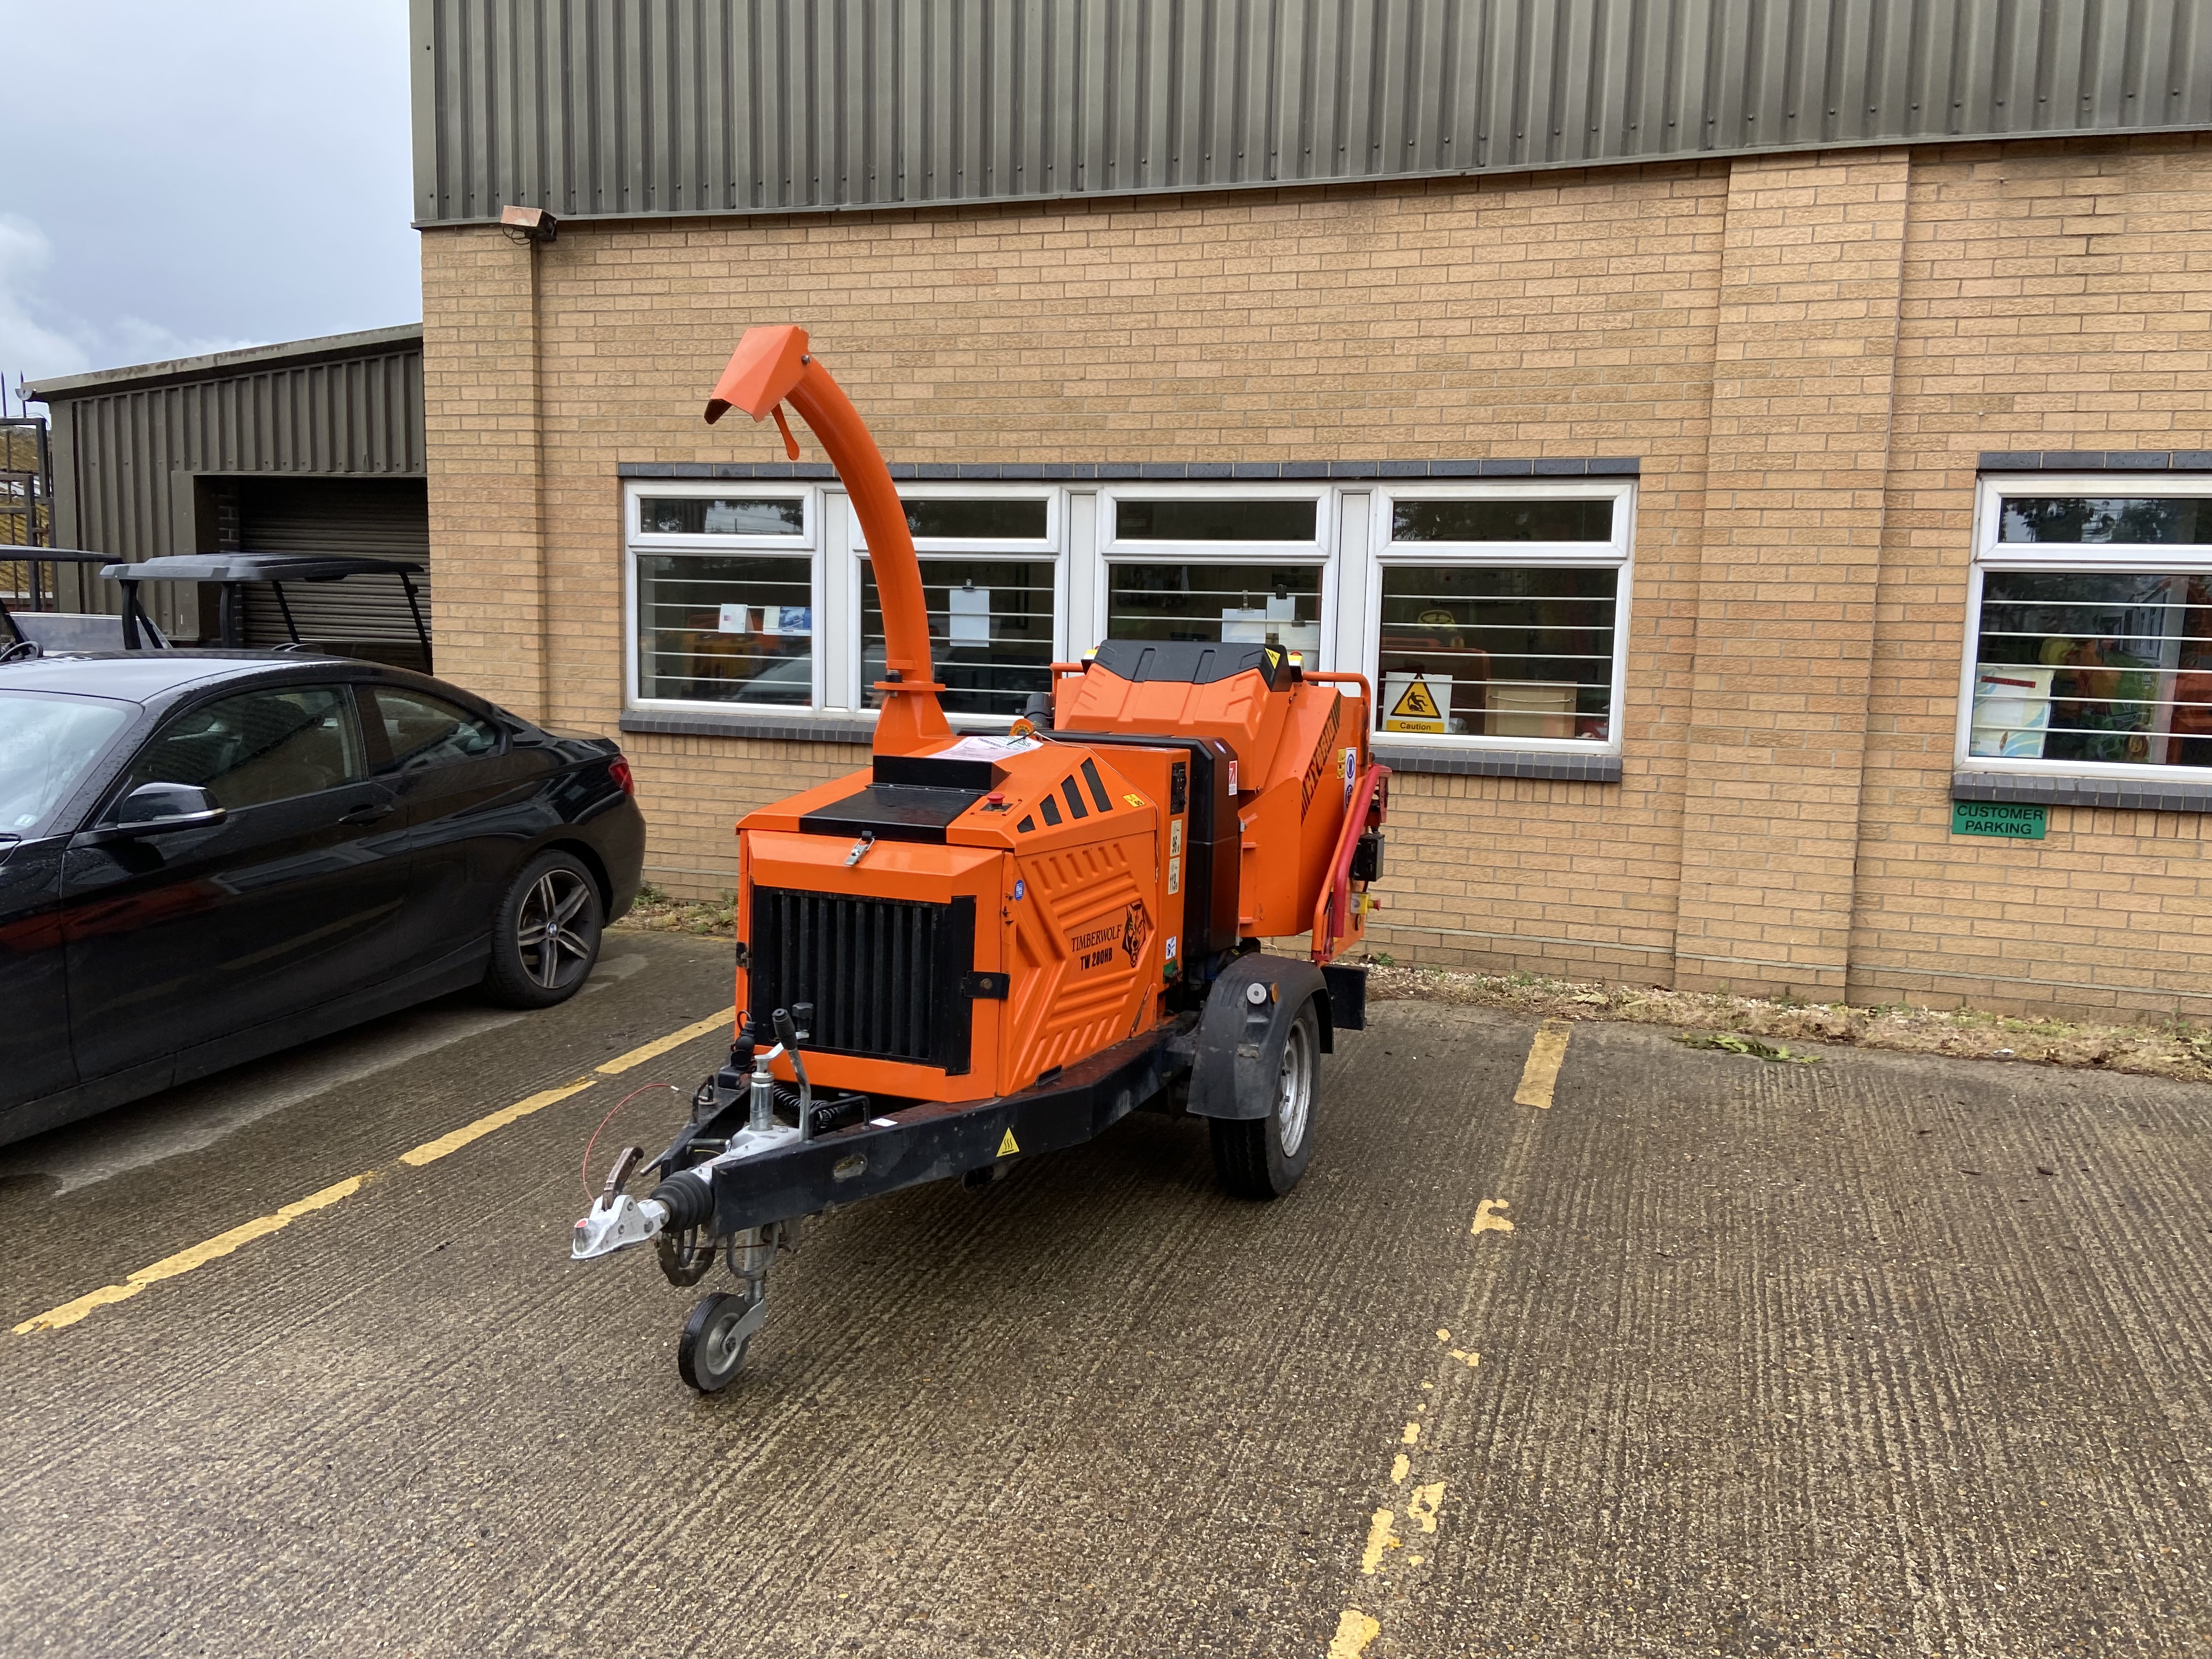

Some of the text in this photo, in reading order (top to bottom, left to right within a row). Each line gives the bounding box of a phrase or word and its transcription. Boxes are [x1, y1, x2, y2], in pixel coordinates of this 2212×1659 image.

[1400, 722, 1431, 731] Caution
[977, 737, 1005, 748] TIMBERWOLF
[1304, 716, 1336, 797] HYBRID
[1957, 805, 2043, 820] CUSTOMER
[1965, 821, 2032, 834] PARKING
[1071, 924, 1122, 952] TIMBERWOLF
[1080, 947, 1113, 971] TW 280HB
